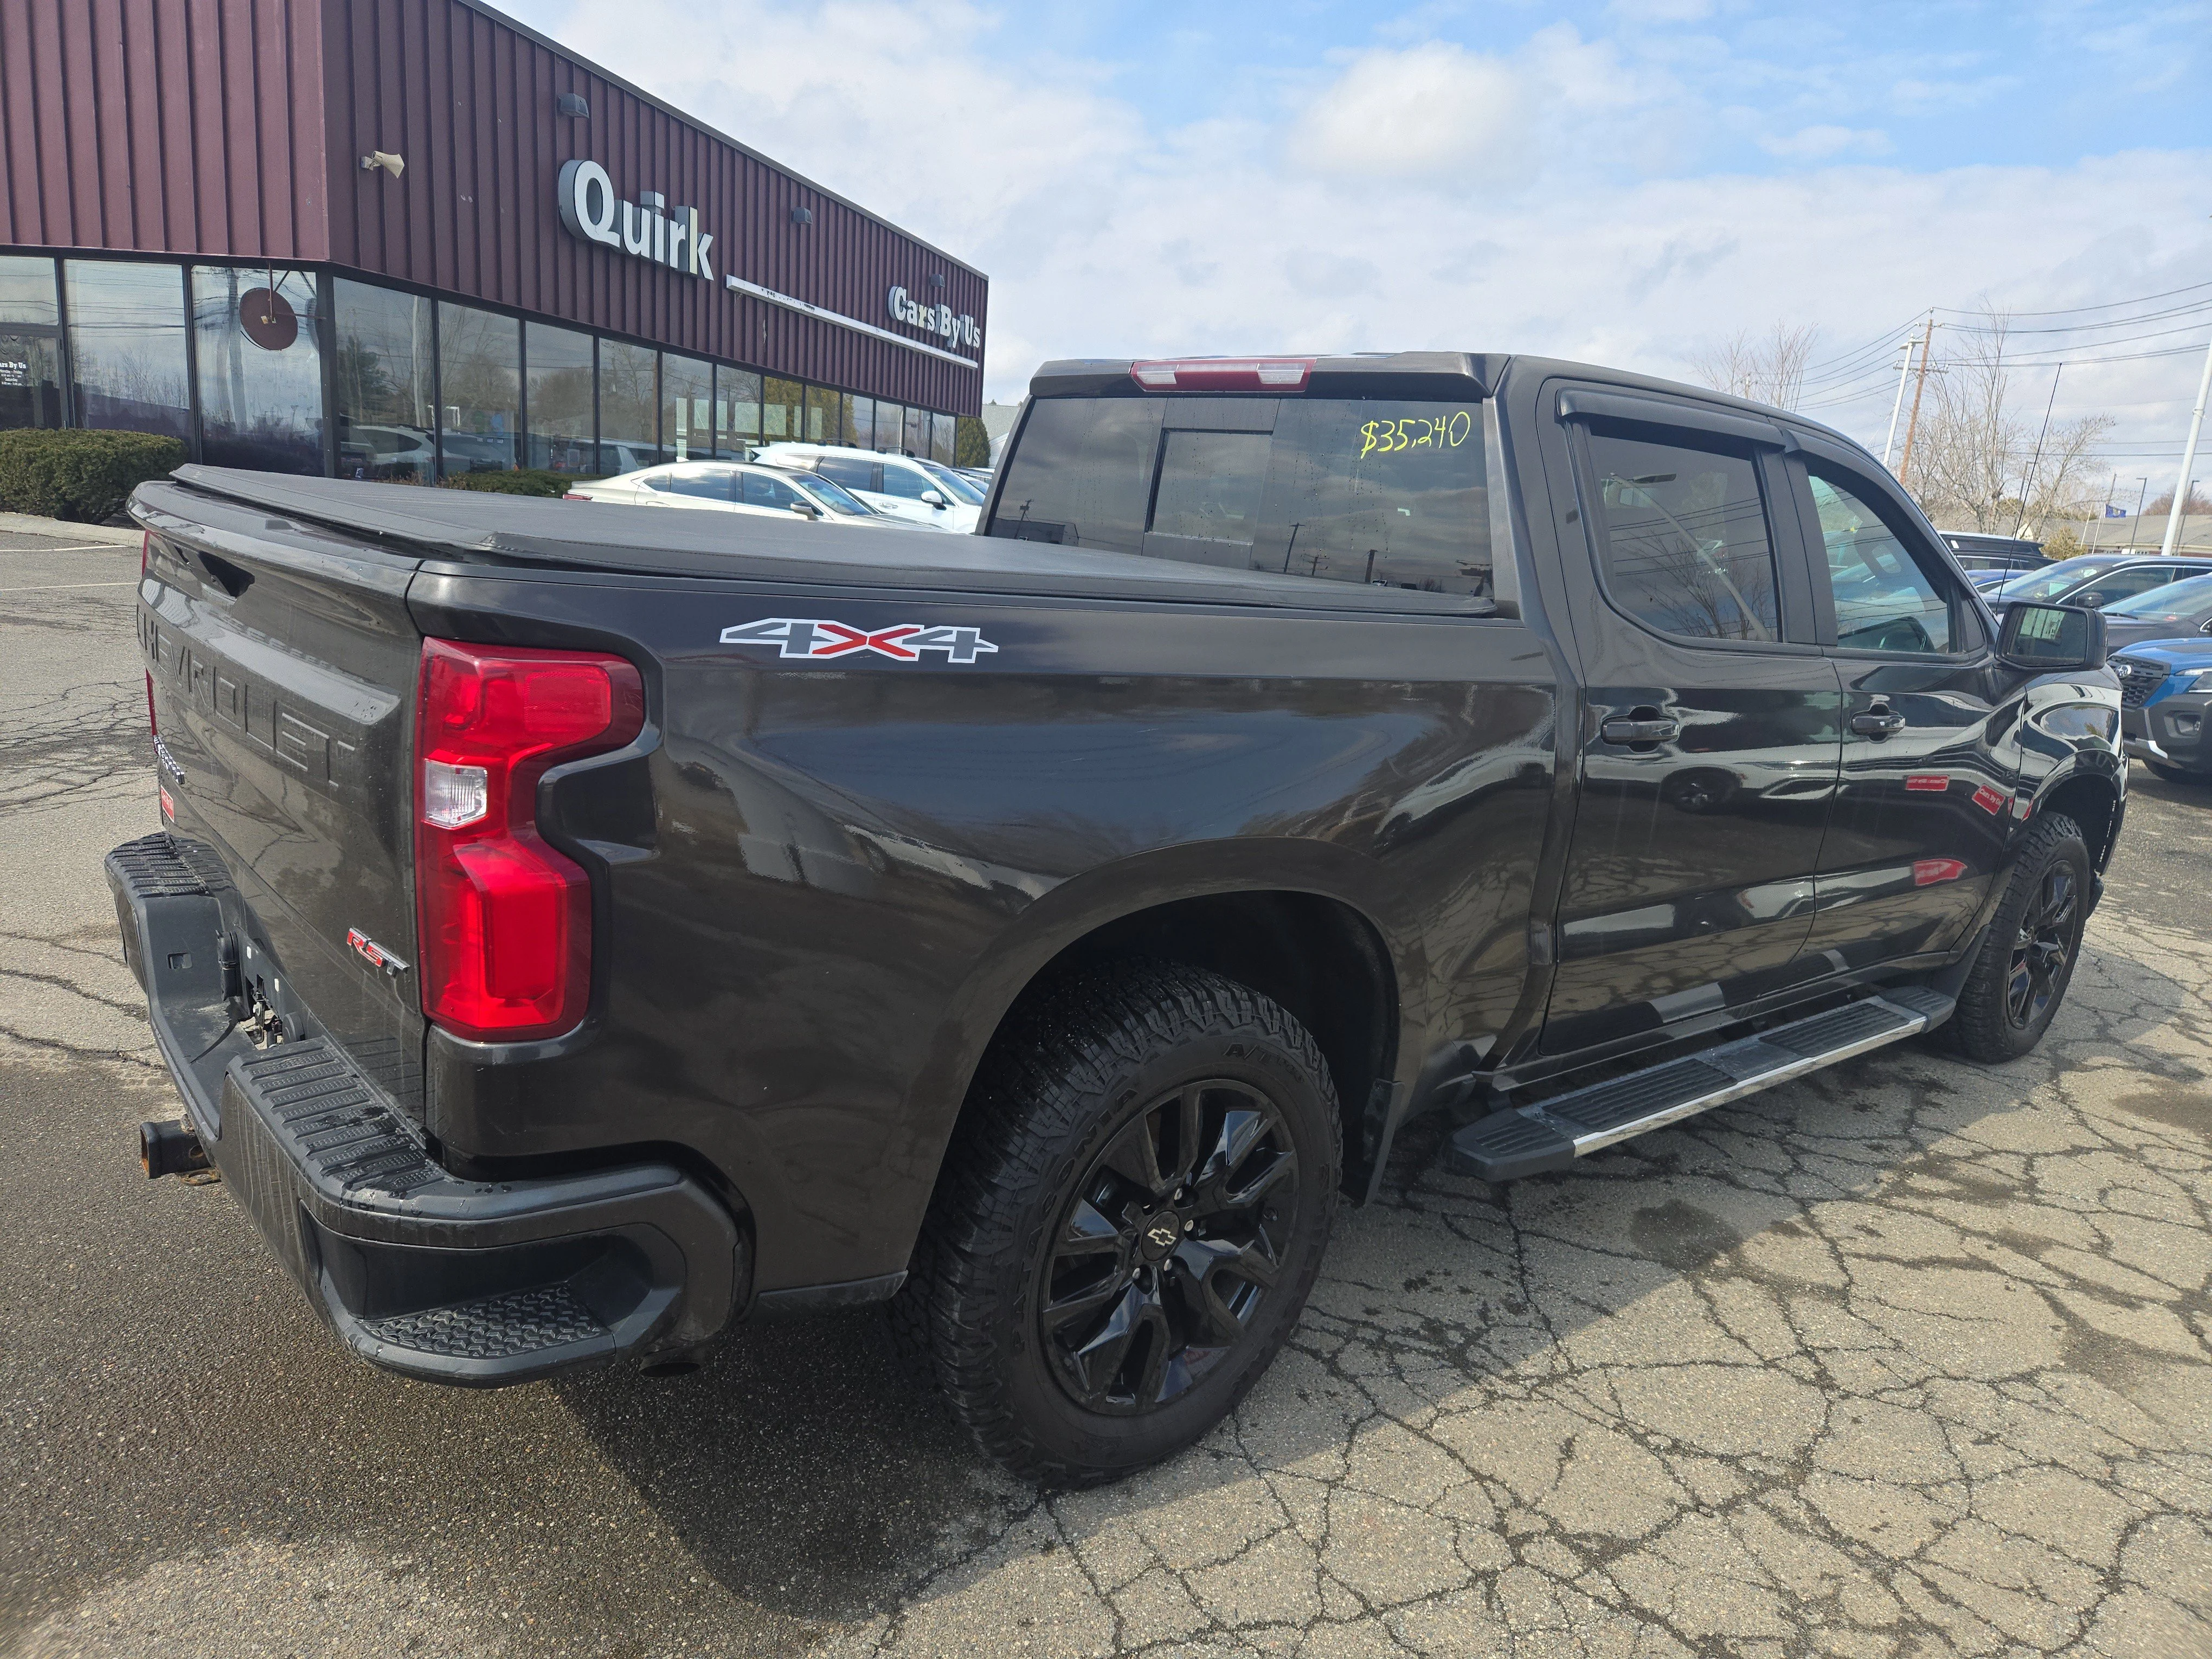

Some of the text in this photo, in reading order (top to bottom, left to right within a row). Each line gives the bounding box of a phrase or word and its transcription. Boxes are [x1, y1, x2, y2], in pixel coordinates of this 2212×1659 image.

[573, 160, 715, 281] Quirk
[893, 286, 980, 349] Cars By Us
[1360, 411, 1470, 459] $35,240
[137, 602, 356, 787] CHEVROLET
[346, 927, 410, 976] RST
